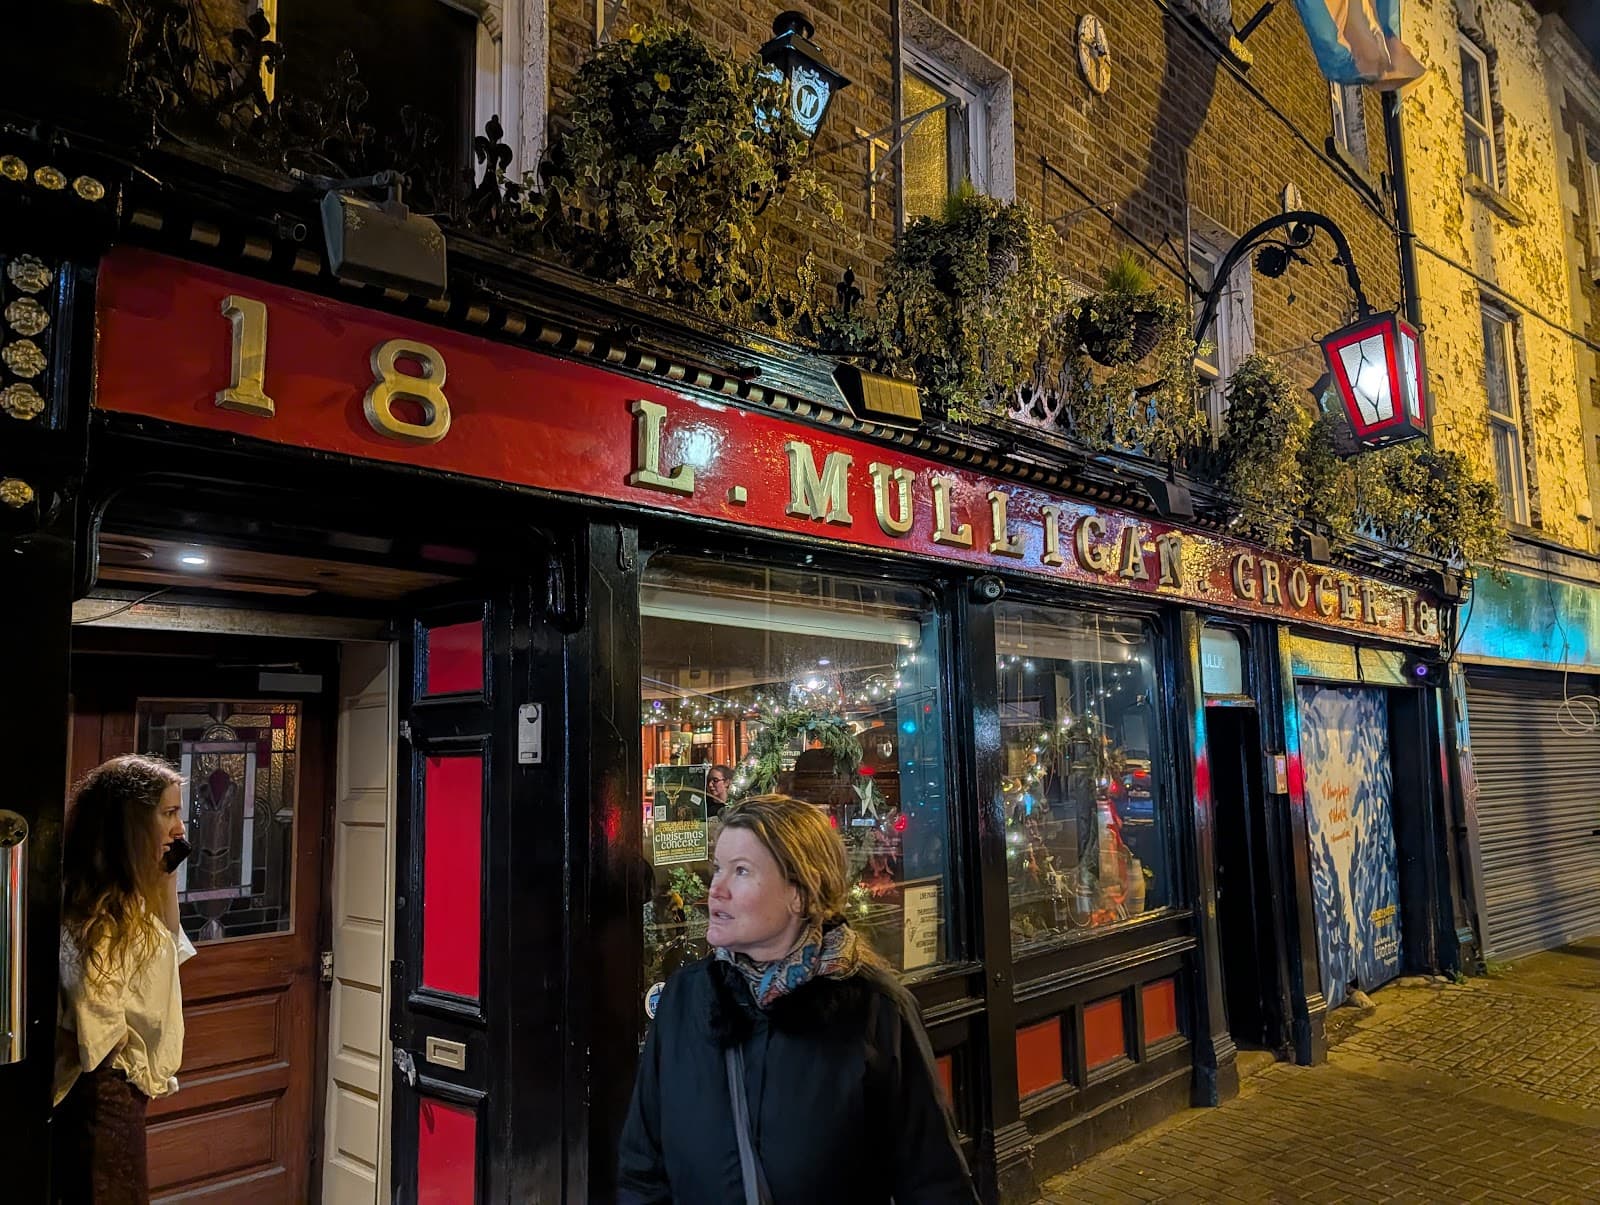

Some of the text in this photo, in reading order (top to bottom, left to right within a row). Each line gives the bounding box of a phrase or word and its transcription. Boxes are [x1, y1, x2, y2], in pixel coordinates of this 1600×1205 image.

[215, 294, 451, 444] 18
[630, 399, 748, 506] L.
[1399, 592, 1431, 636] 18
